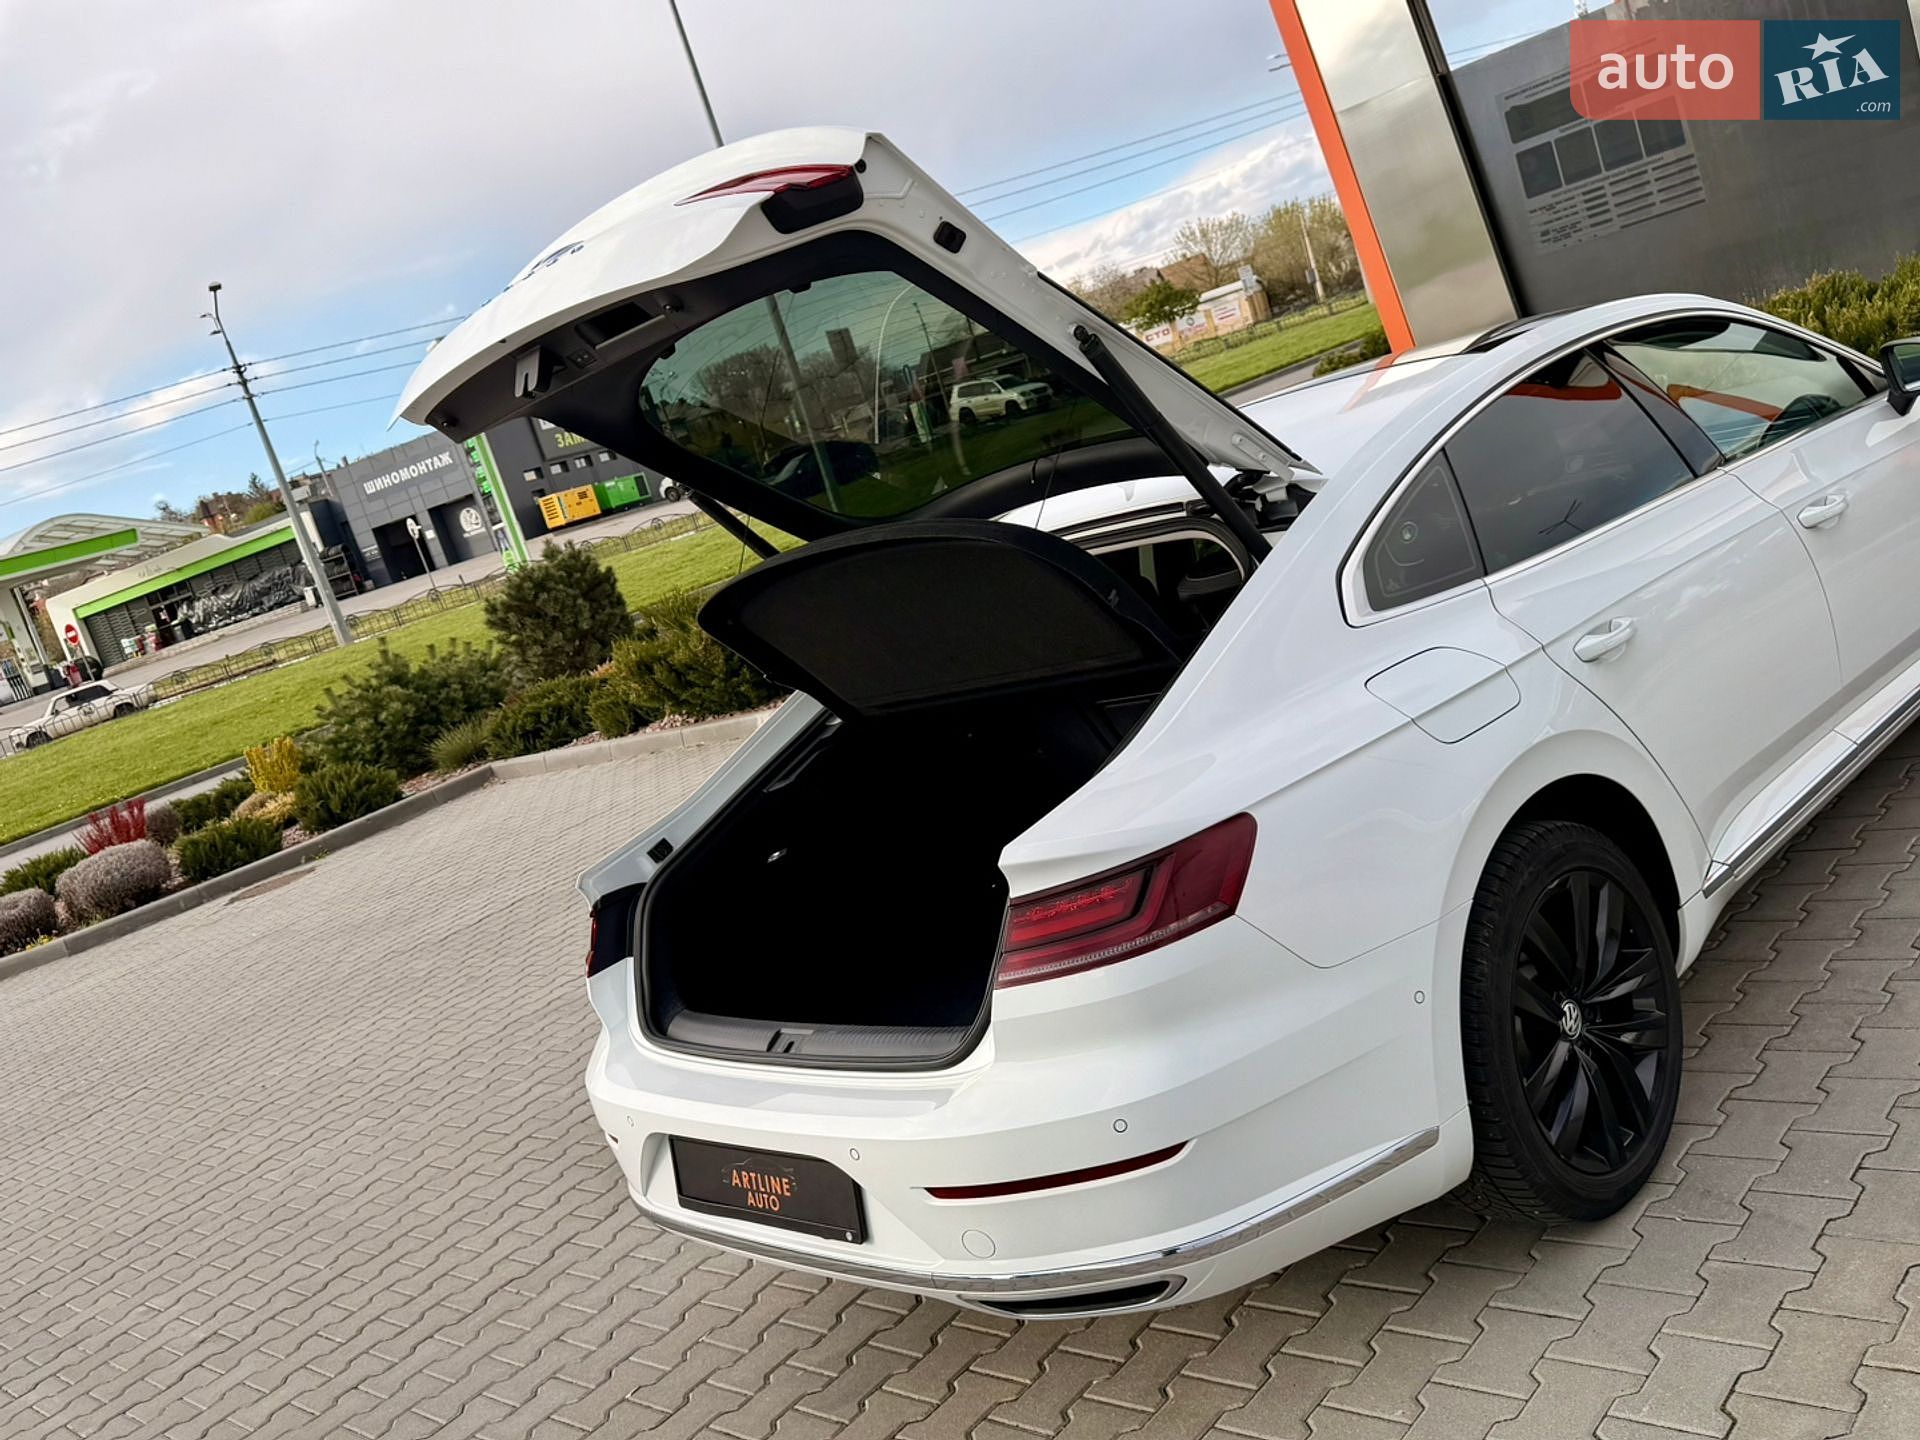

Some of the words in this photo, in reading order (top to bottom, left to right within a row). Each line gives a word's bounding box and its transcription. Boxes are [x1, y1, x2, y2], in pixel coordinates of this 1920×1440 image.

[363, 451, 453, 495] ШИНОМОНТАЖ
[731, 1169, 792, 1197] ARTLINE
[747, 1191, 780, 1211] AUTO
